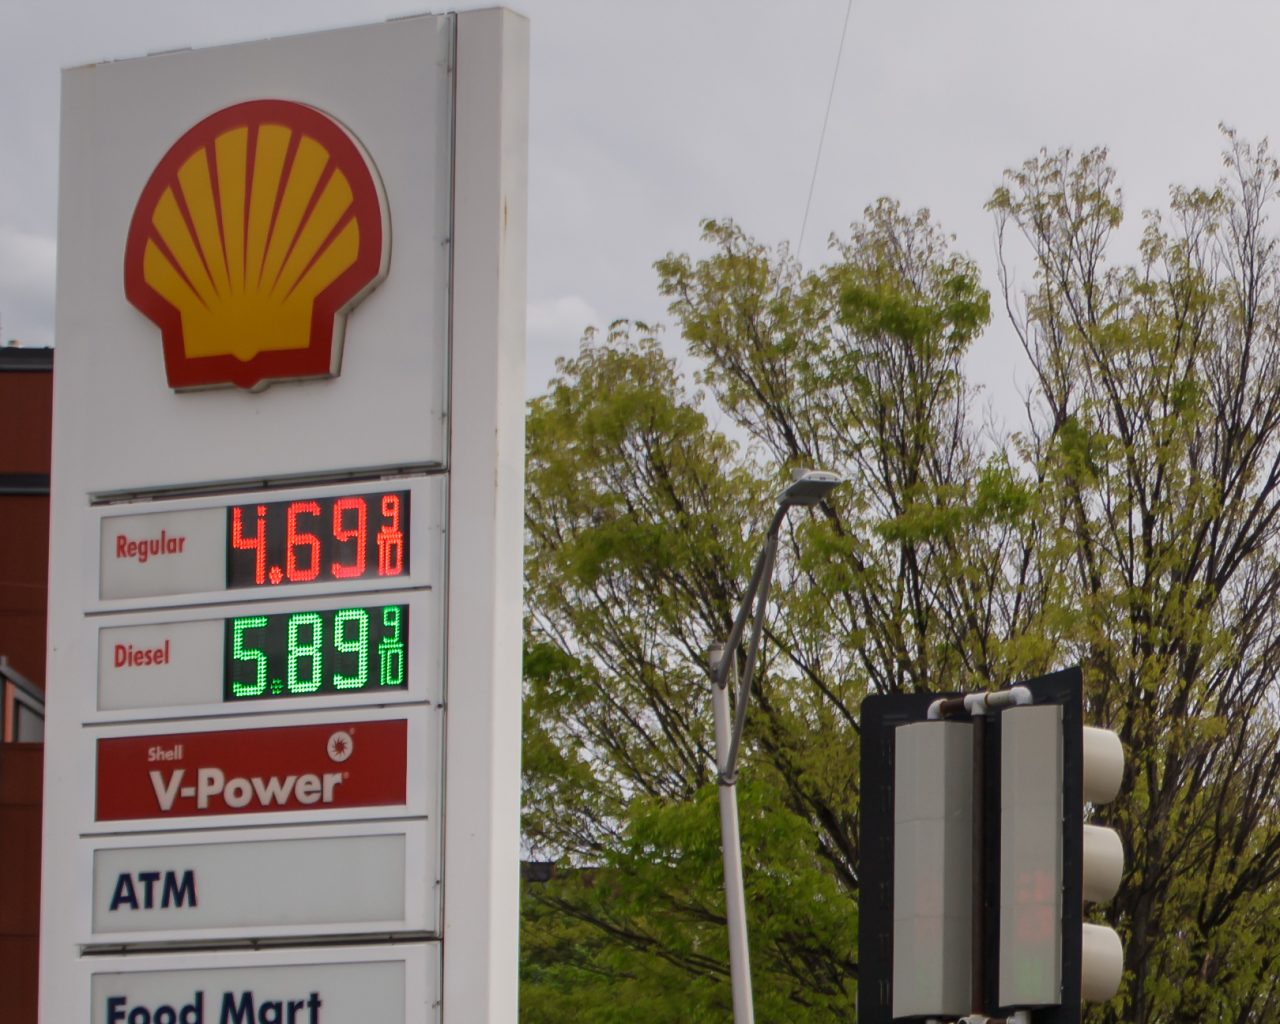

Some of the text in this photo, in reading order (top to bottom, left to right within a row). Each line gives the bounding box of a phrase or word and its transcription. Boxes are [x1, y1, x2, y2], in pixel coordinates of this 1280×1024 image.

[115, 531, 186, 563] Regular
[232, 497, 368, 585] 4.69
[113, 639, 171, 668] Diesel
[232, 607, 369, 697] 5.89
[147, 745, 184, 762] Shell
[148, 767, 343, 812] V-Power
[109, 870, 198, 911] ATM
